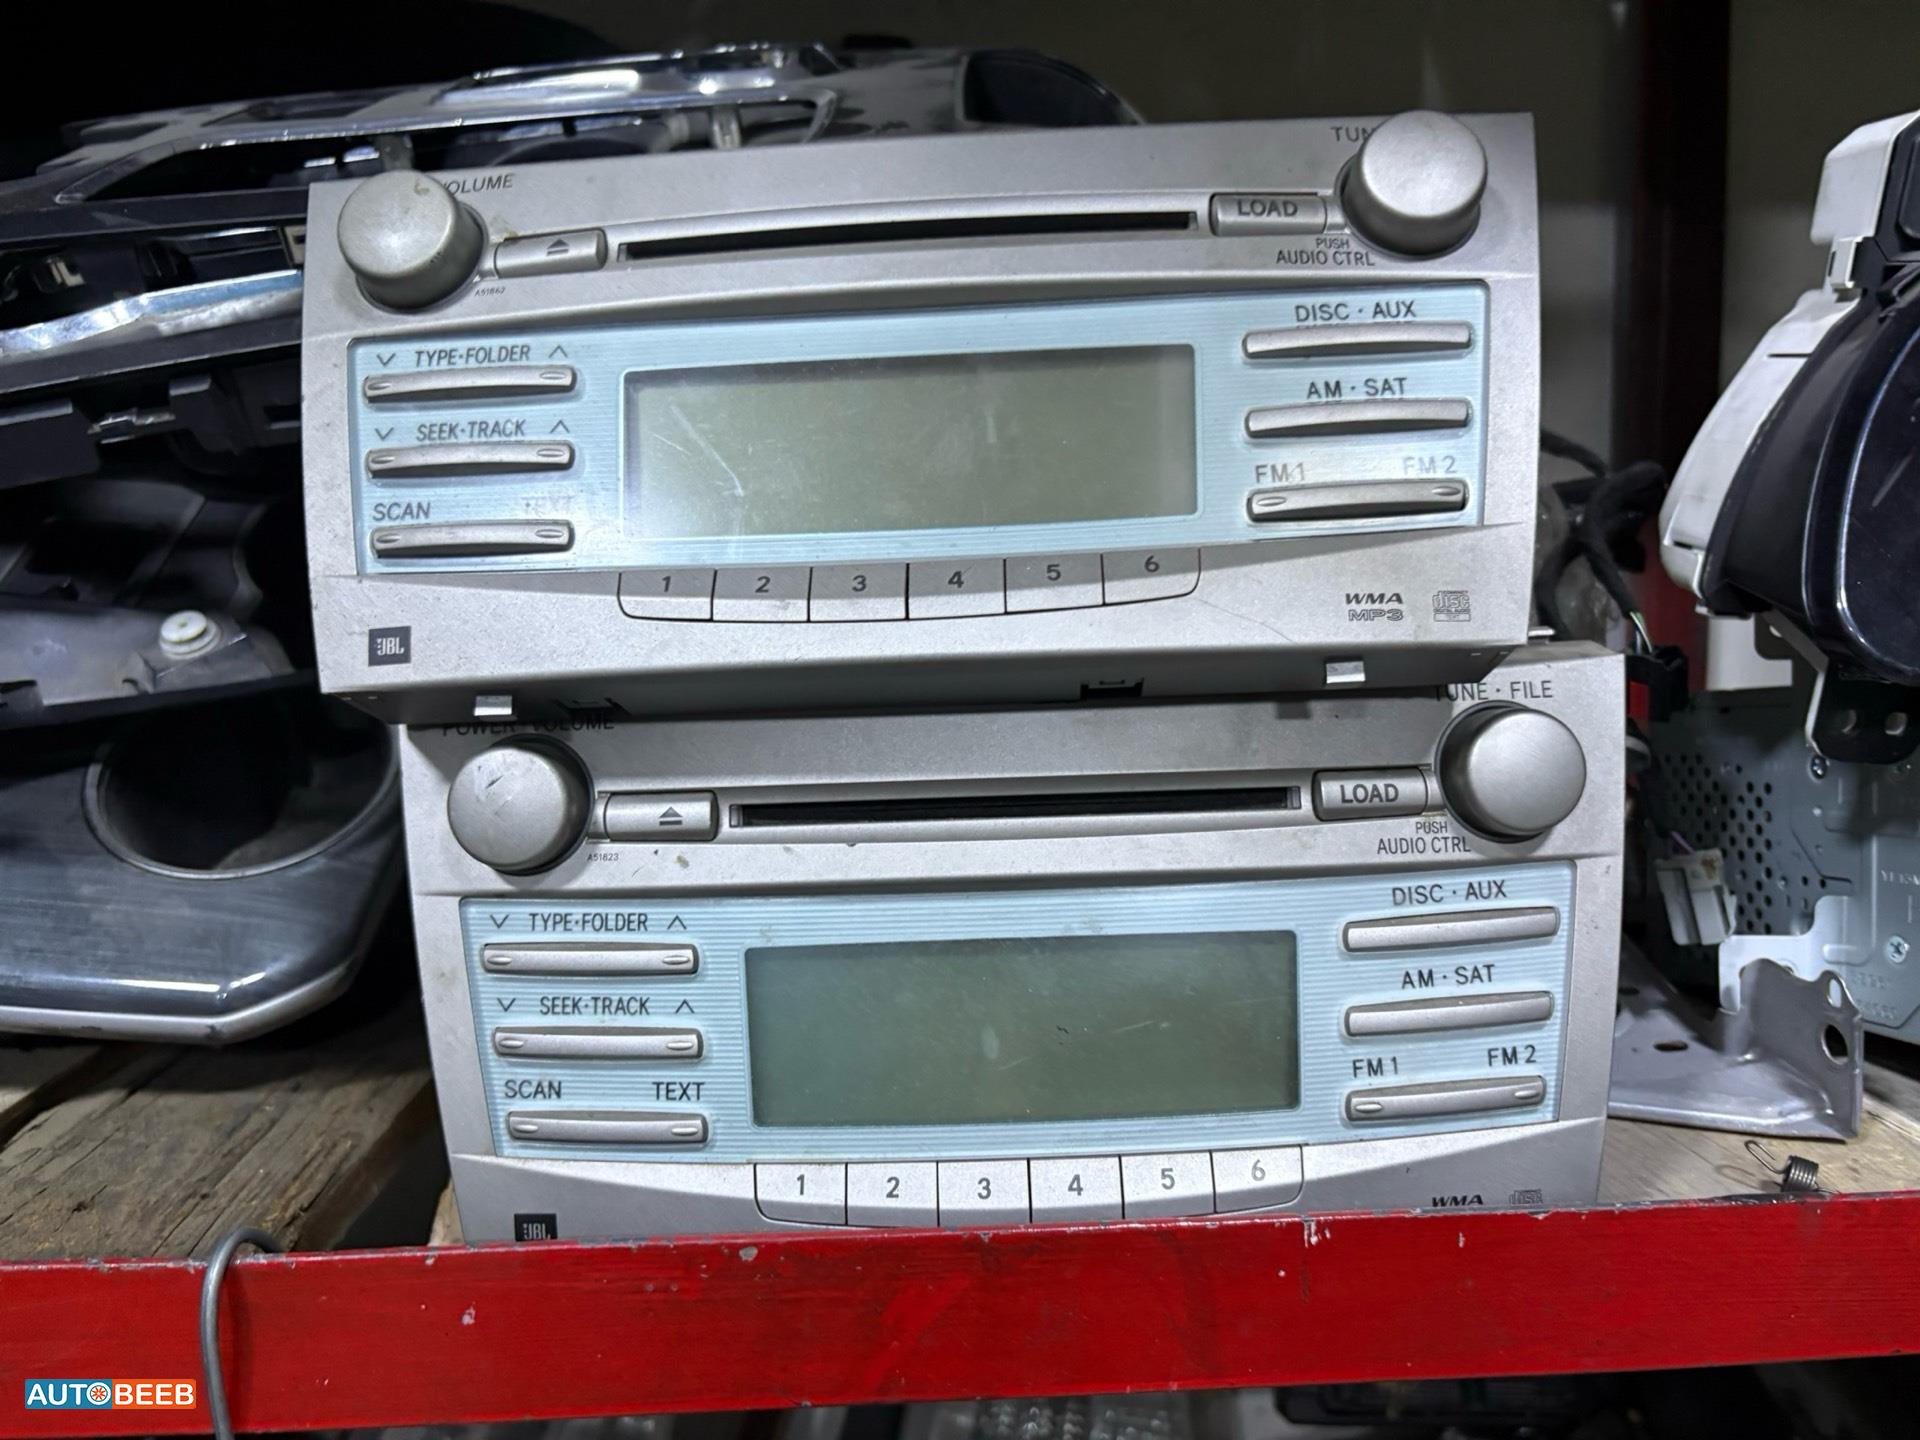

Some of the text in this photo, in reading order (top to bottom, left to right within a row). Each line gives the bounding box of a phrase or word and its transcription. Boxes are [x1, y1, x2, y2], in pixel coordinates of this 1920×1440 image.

[1331, 126, 1376, 142] TUN
[444, 173, 513, 196] OLUME
[1238, 200, 1298, 217] LOAD
[1316, 238, 1350, 249] PUSH
[1277, 251, 1375, 266] AUDIO CTRL
[1295, 301, 1417, 322] DISC AUX
[1307, 377, 1407, 398] AM SAT
[372, 502, 431, 522] SCAN
[1045, 563, 1061, 581] 5
[1144, 555, 1160, 573] 6
[662, 577, 672, 592] 1
[756, 576, 771, 593] 2
[851, 575, 868, 592] 3
[947, 570, 964, 590] 4
[1344, 592, 1404, 605] WMA
[1347, 609, 1404, 622] MP3
[376, 637, 405, 656] JBL
[1510, 680, 1553, 699] FILE
[1340, 784, 1399, 803] LOAD
[1415, 821, 1448, 834] PUSH
[1377, 837, 1471, 855] AUDIO CTRL
[1392, 880, 1507, 906] DISC AUX
[1401, 964, 1496, 989] AM SAT
[1487, 1044, 1537, 1067] FM 2
[1352, 1056, 1399, 1078] FM 1
[504, 1080, 562, 1099] SCAN
[652, 1082, 705, 1101] TEXT
[1161, 1168, 1175, 1190] 5
[1251, 1159, 1266, 1181] 6
[796, 1175, 806, 1196] 1
[886, 1177, 900, 1199] 2
[977, 1178, 992, 1200] 3
[1067, 1174, 1083, 1197] 4
[1431, 1194, 1484, 1207] WMA
[522, 1223, 551, 1240] JBL
